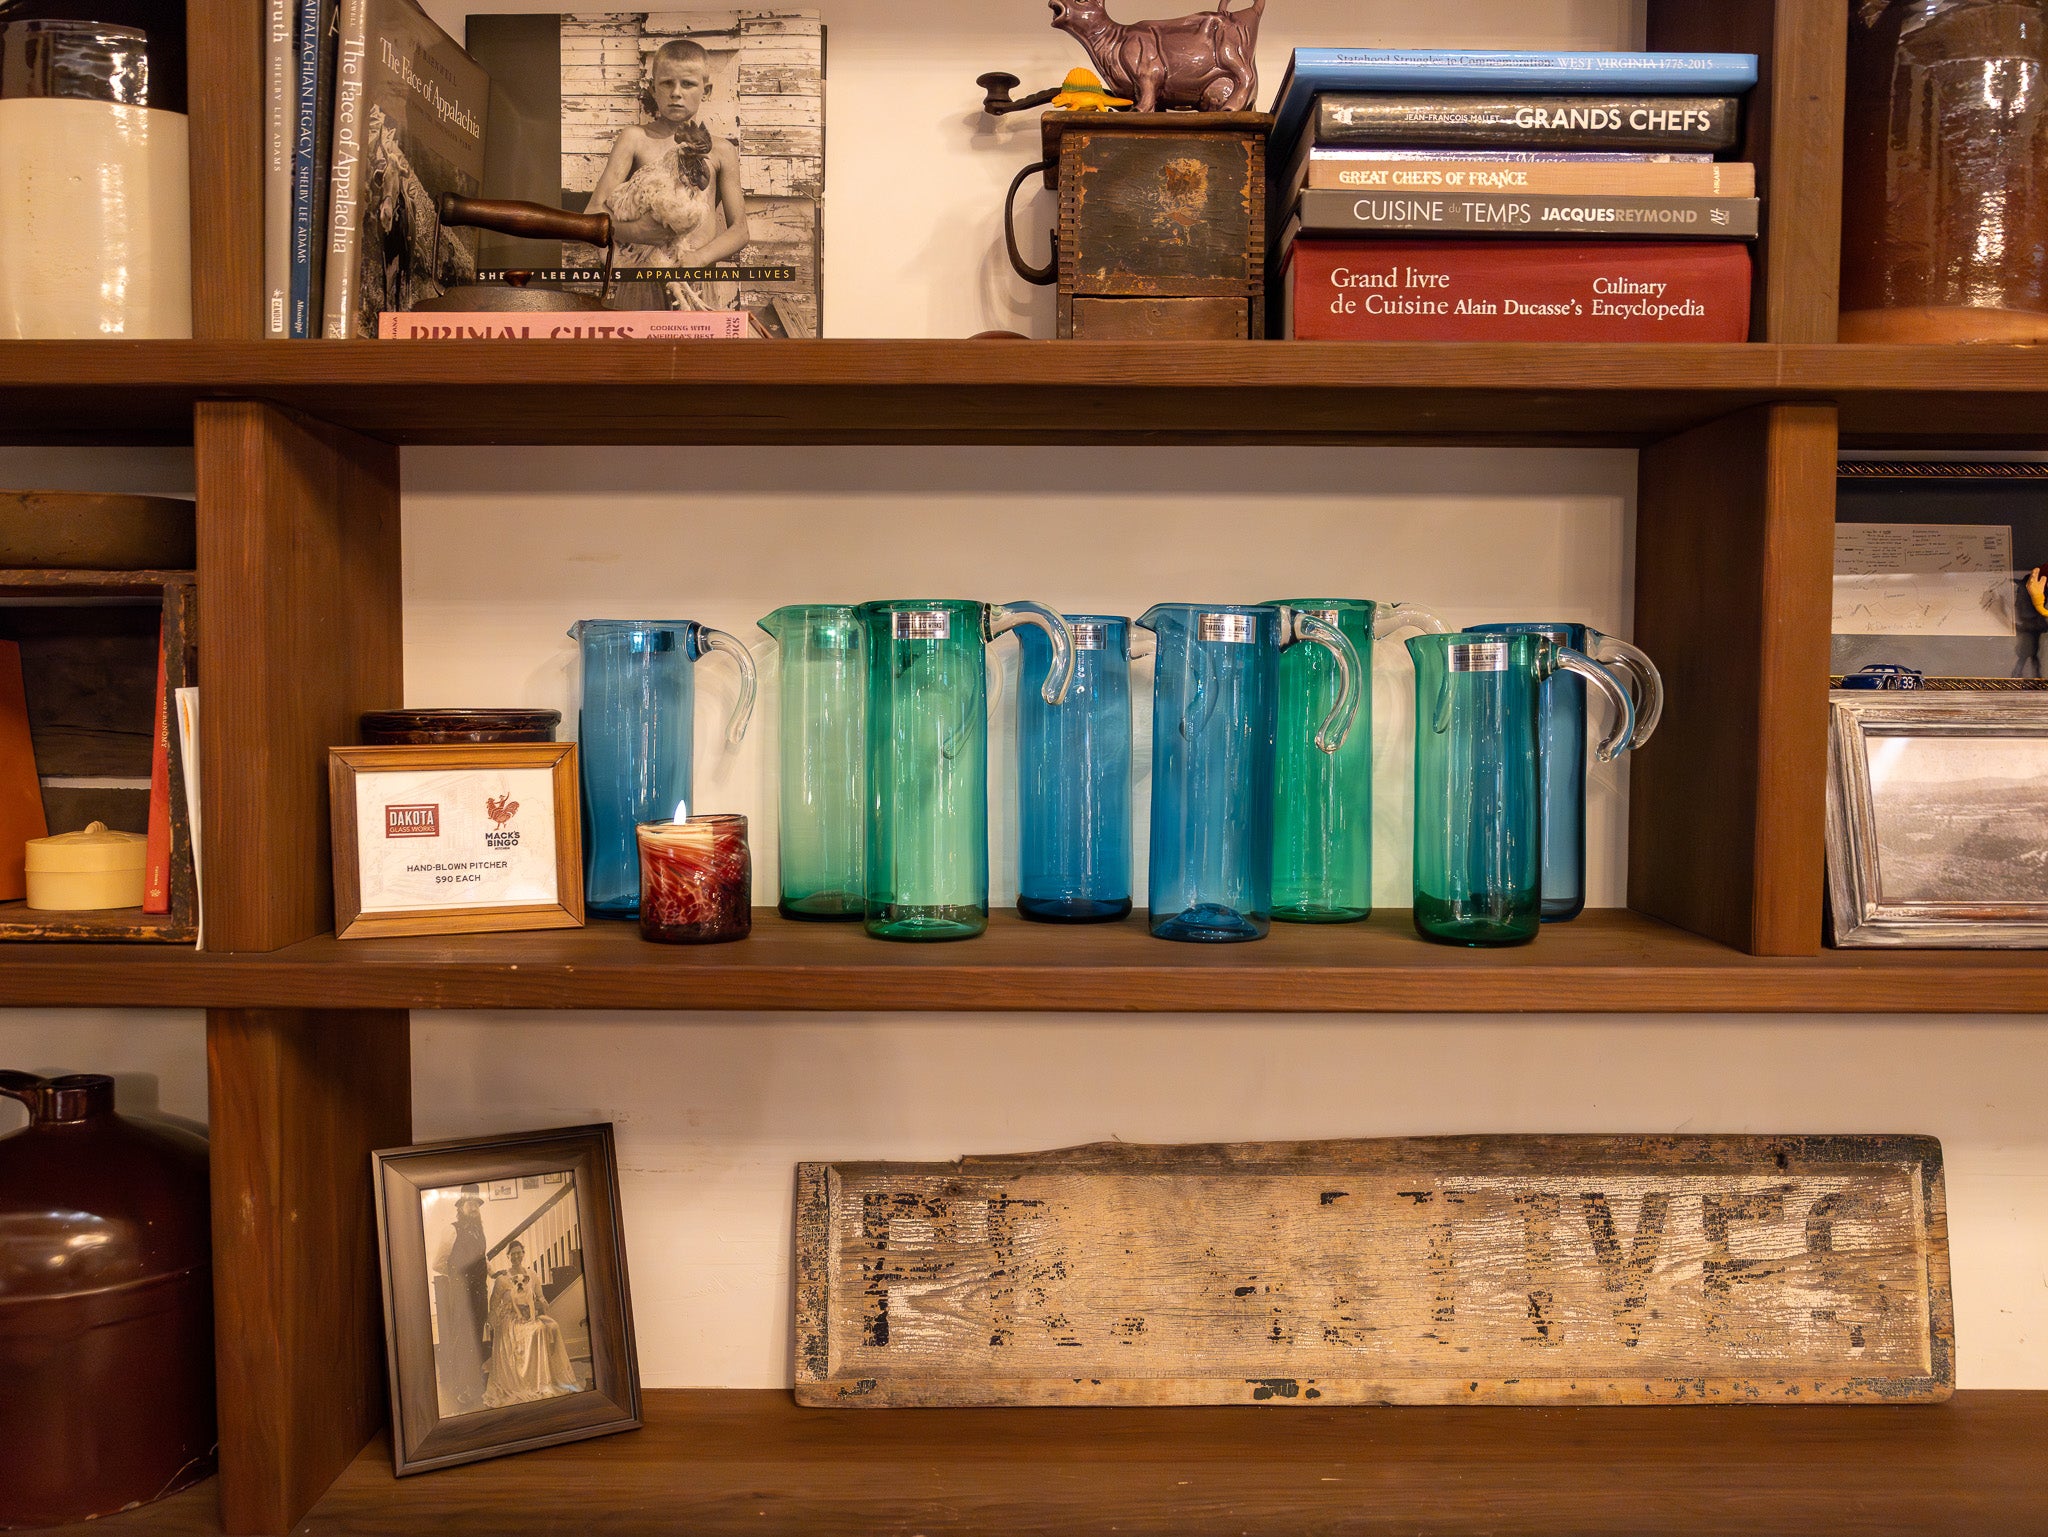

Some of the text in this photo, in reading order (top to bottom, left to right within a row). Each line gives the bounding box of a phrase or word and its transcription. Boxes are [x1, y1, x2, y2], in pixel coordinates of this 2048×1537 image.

[1557, 57, 1593, 69] WEST
[1596, 58, 1656, 69] VIRGINIA
[380, 37, 400, 74] The
[401, 55, 422, 93] Face
[423, 79, 434, 102] of
[431, 86, 480, 139] Appalachia
[1470, 114, 1500, 123] MALLET
[1515, 107, 1711, 132] GRANDS CHEFS
[297, 0, 316, 264] APPALACHIAN LEGACY SHELBY LEE ADAMS
[272, 132, 282, 172] ADAMS
[331, 35, 365, 254] The Face of Appalachia
[1339, 169, 1528, 189] GREAT CHEFS OF FRANCE
[1353, 199, 1444, 222] CUISINE
[1448, 203, 1461, 214] du
[1461, 202, 1531, 224] TEMPS
[479, 268, 791, 281] SHE LEE ADAS APPALACHIAN LIVES
[1330, 266, 1450, 288] Grand livre
[1592, 276, 1667, 299] Culinary
[272, 300, 282, 330] CANDELA
[294, 299, 305, 334] Mississippi
[1330, 293, 1705, 321] de Cuisine Alain Ducasse's Encyclopedia
[1902, 676, 1914, 689] 33
[389, 810, 434, 827] DAKOTA
[485, 831, 520, 840] MACK'S
[487, 839, 519, 847] BINGO
[406, 860, 508, 873] HAND-BLOWN PITCHER
[435, 874, 481, 884] $90 EACH
